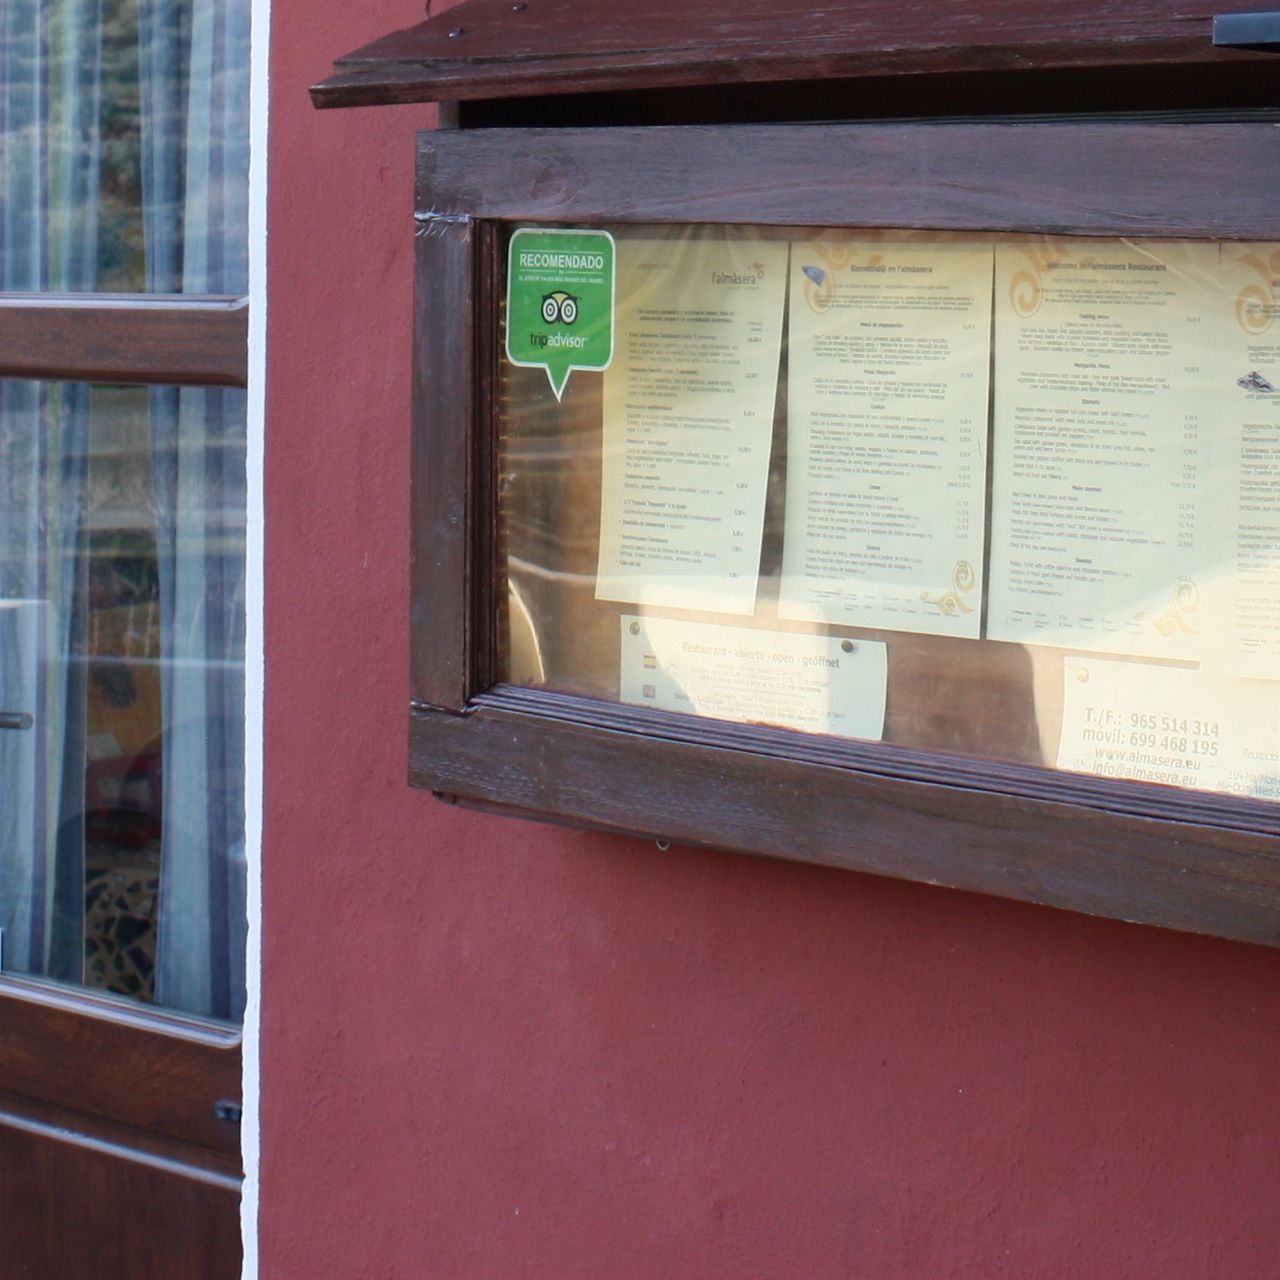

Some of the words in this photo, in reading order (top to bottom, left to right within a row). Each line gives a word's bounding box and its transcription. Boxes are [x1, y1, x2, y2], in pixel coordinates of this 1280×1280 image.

[519, 253, 604, 269] RECOMENDADO
[530, 332, 587, 349] tripadvisor
[773, 654, 794, 664] open
[1130, 713, 1157, 730] 965
[1161, 717, 1188, 734] 514
[1192, 720, 1220, 738] 314
[1083, 725, 1126, 745] móvil:
[1130, 731, 1156, 748] 699
[1160, 736, 1188, 753] 468
[1192, 739, 1219, 757] 195
[1095, 747, 1201, 771] www.almasera.eu
[1092, 761, 1198, 787] info@almasera.eu
